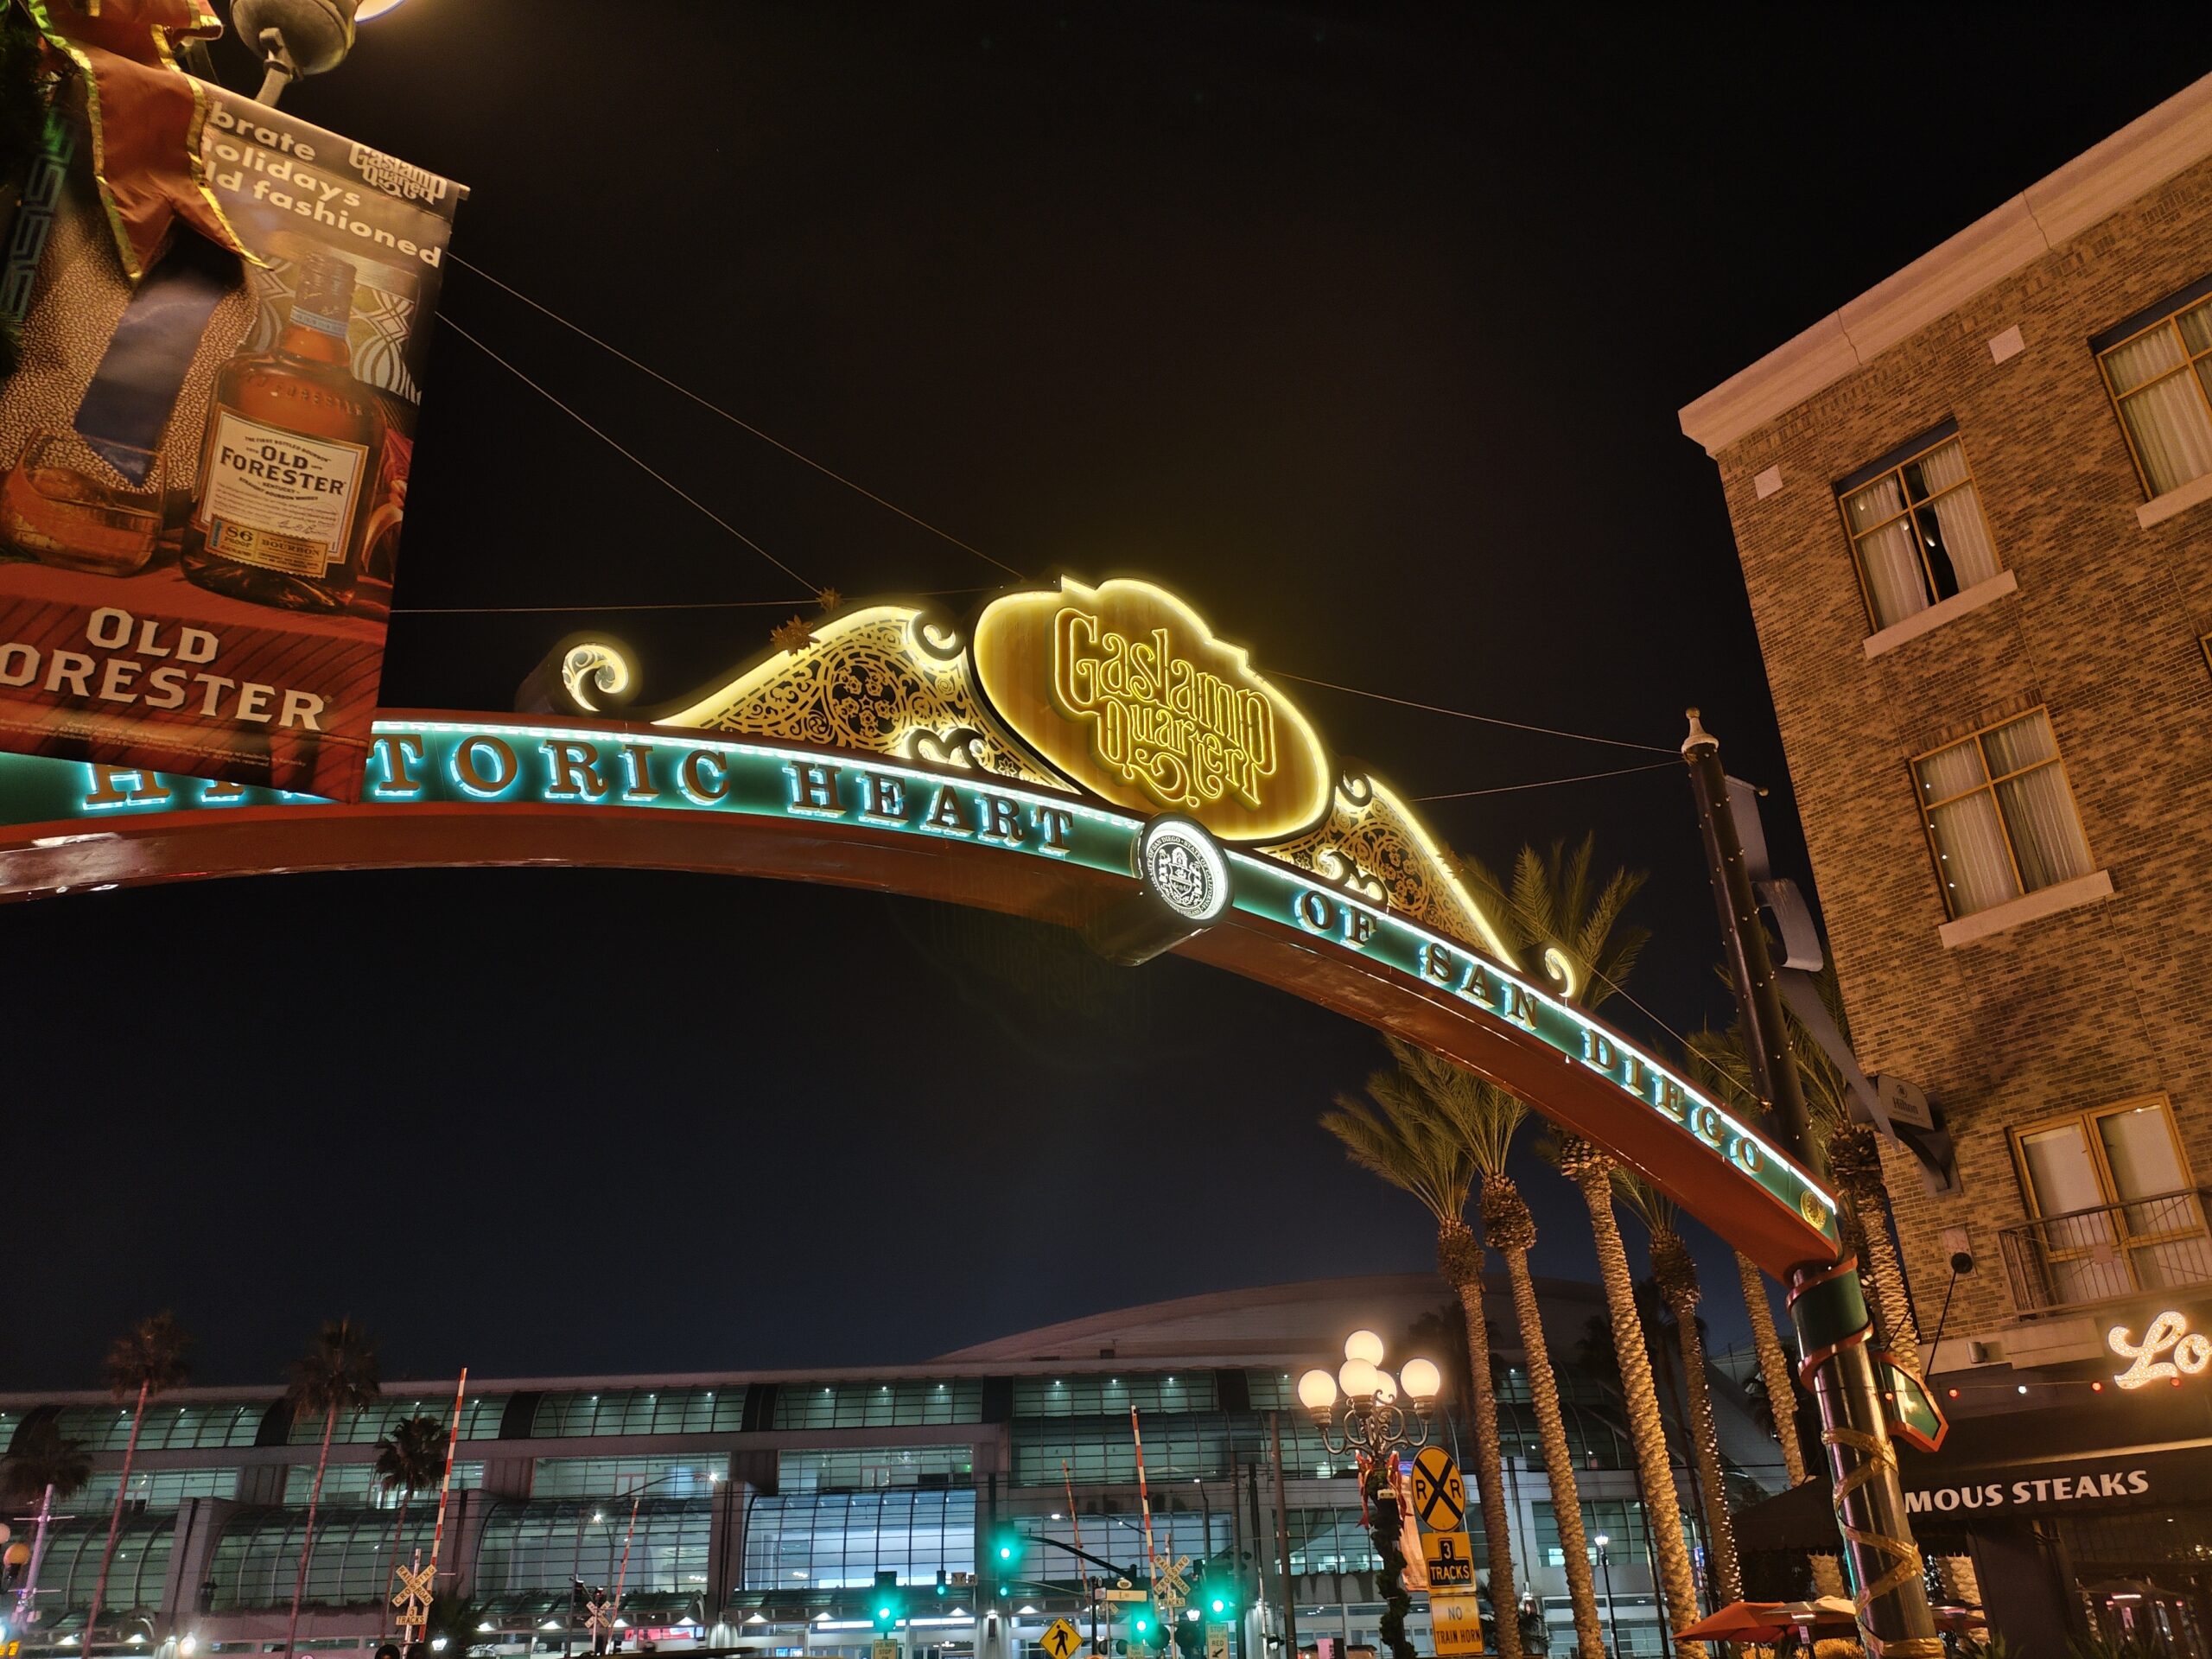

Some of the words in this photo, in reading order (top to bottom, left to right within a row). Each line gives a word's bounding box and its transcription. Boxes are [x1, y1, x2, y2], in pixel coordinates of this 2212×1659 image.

[208, 101, 316, 162] brate
[252, 180, 442, 269] fashioned
[219, 446, 344, 496] FORESTER
[261, 445, 308, 470] OLD
[224, 537, 252, 549] PROOF
[226, 525, 253, 542] 86
[261, 538, 320, 556] BOURBON
[86, 607, 219, 664] OLD
[1054, 607, 1277, 776] Gaslamp
[1096, 696, 1262, 808] Quarter
[1148, 848, 1155, 858] OF
[1151, 838, 1162, 850] SAN
[1183, 841, 1202, 858] STATE
[82, 733, 730, 811] HTORIC
[783, 760, 1075, 855] HEART
[1294, 890, 1378, 949] OF
[1420, 942, 1540, 1031] SAN
[1580, 1027, 1765, 1176] DIEGO
[1892, 1096, 1919, 1115] Hilton
[2108, 1310, 2212, 1390] Lo
[1904, 1483, 2004, 1514] MOUS
[2012, 1470, 2150, 1504] STEAKS
[1443, 1542, 1452, 1560] 3
[394, 1567, 435, 1605] CROSSING
[398, 1567, 431, 1604] RAILROAD
[1155, 1556, 1189, 1592] RAILROAD
[1155, 1556, 1188, 1592] CROSSING
[1430, 1565, 1470, 1580] TRACKS
[1447, 1606, 1462, 1620] NO
[1436, 1629, 1459, 1644] TRAIN
[1460, 1627, 1481, 1643] HORN
